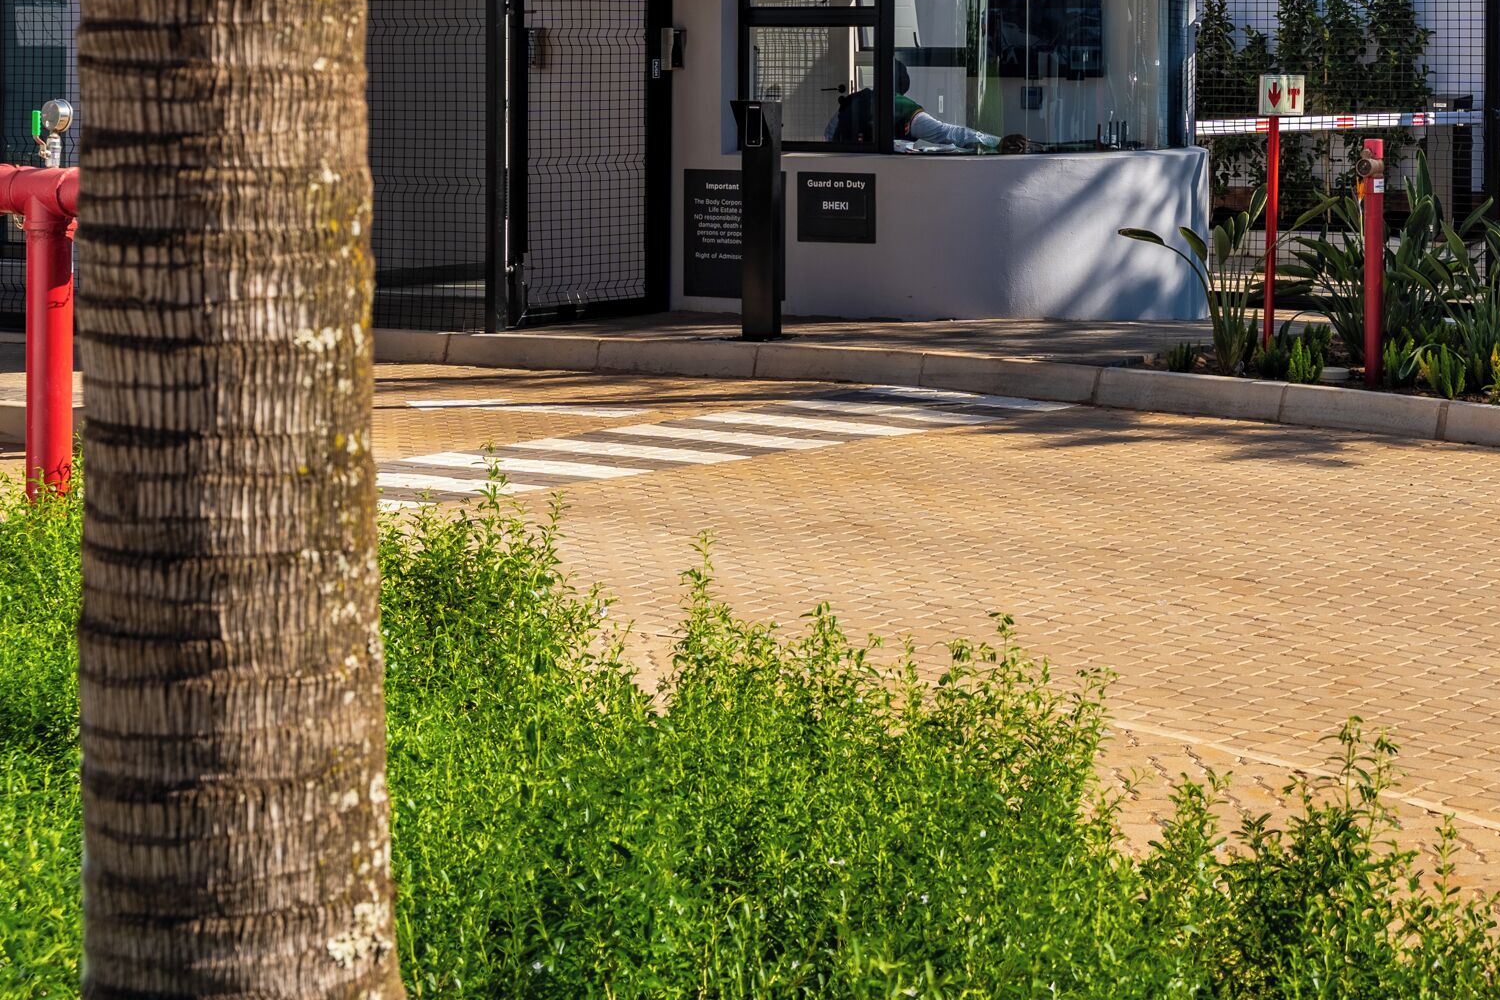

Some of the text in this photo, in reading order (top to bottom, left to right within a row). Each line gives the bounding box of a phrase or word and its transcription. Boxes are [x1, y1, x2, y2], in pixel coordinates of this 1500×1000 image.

[705, 182, 740, 190] Important
[807, 179, 832, 188] Guard
[846, 180, 866, 190] Duty
[705, 198, 720, 206] Body
[822, 201, 849, 210] BHEKI
[720, 206, 738, 214] Estate
[704, 214, 741, 223] responsibility
[695, 251, 710, 259] Right
